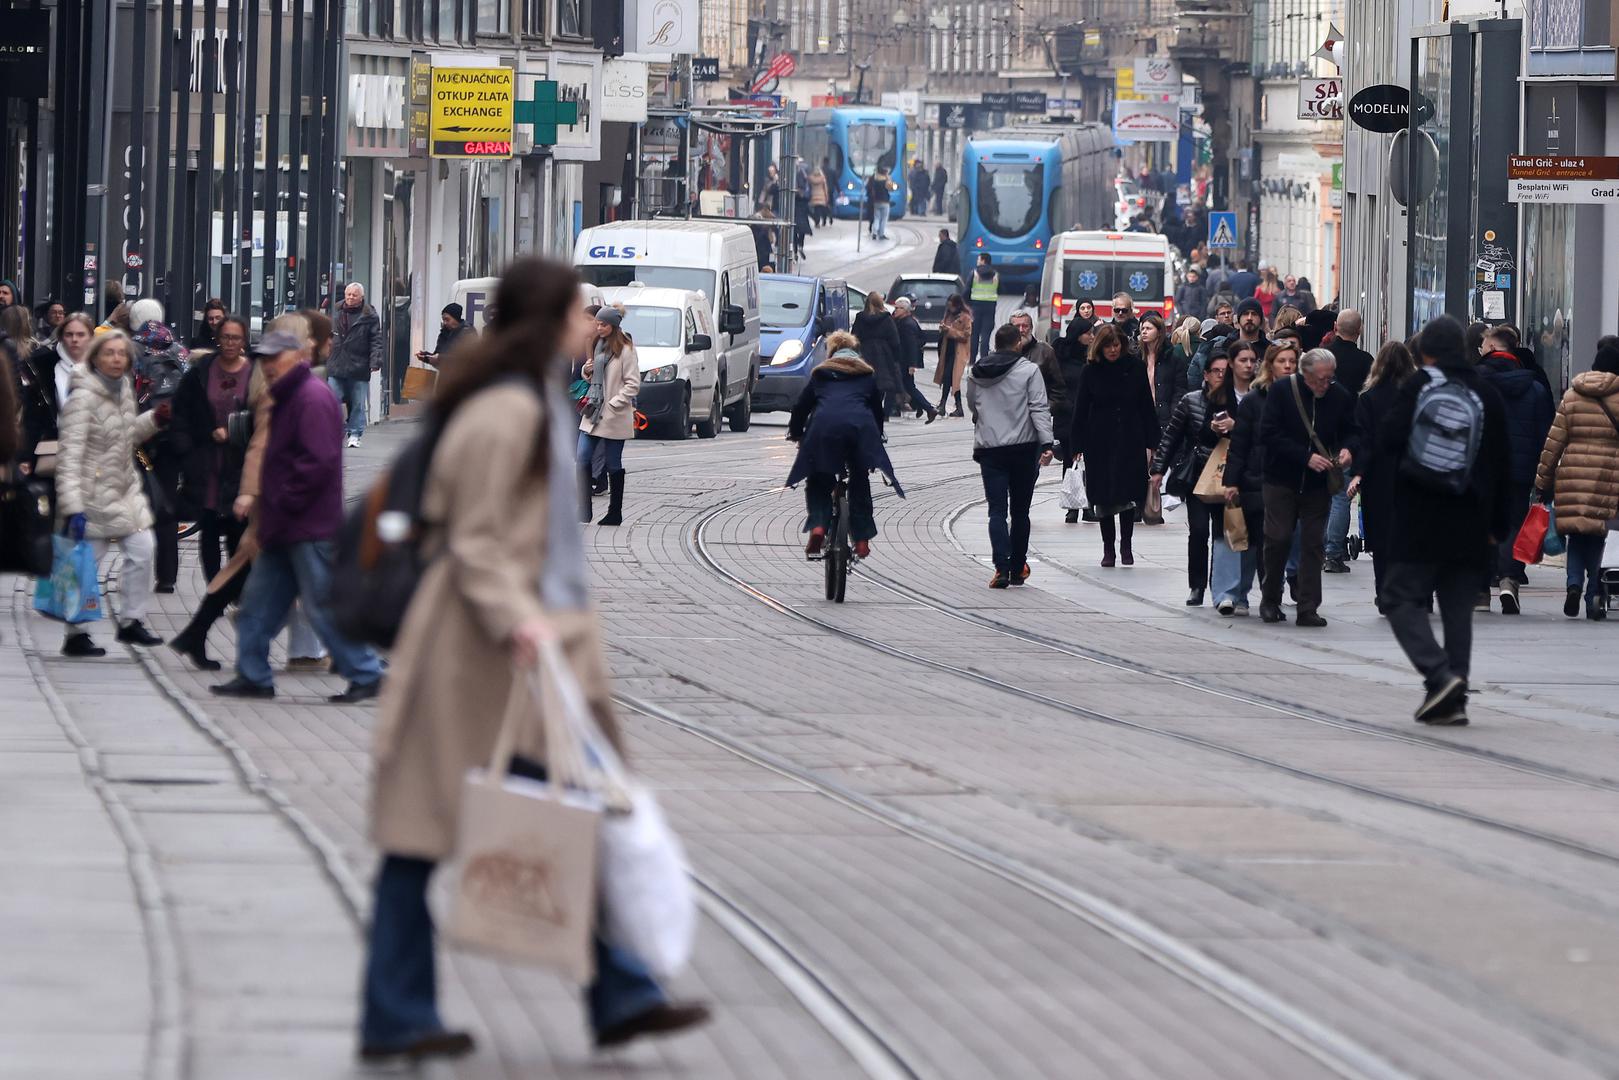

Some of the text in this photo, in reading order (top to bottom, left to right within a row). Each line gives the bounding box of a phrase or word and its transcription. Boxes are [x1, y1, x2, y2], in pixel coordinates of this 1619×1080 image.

[691, 65, 717, 75] GAR
[1315, 81, 1343, 99] SA
[437, 91, 509, 102] OTKUP ZLATA
[443, 106, 503, 117] EXCHANGE
[1353, 103, 1409, 114] MODELIN
[1511, 158, 1534, 167] Tunel
[1536, 158, 1553, 168] Grič
[1560, 159, 1578, 168] ulaz
[1579, 159, 1585, 168] 4
[1512, 168, 1535, 176] Tunnel
[1536, 168, 1551, 176] Grič
[1556, 169, 1586, 177] entrance
[1517, 183, 1551, 192] Besplatni
[1591, 188, 1614, 197] Grad
